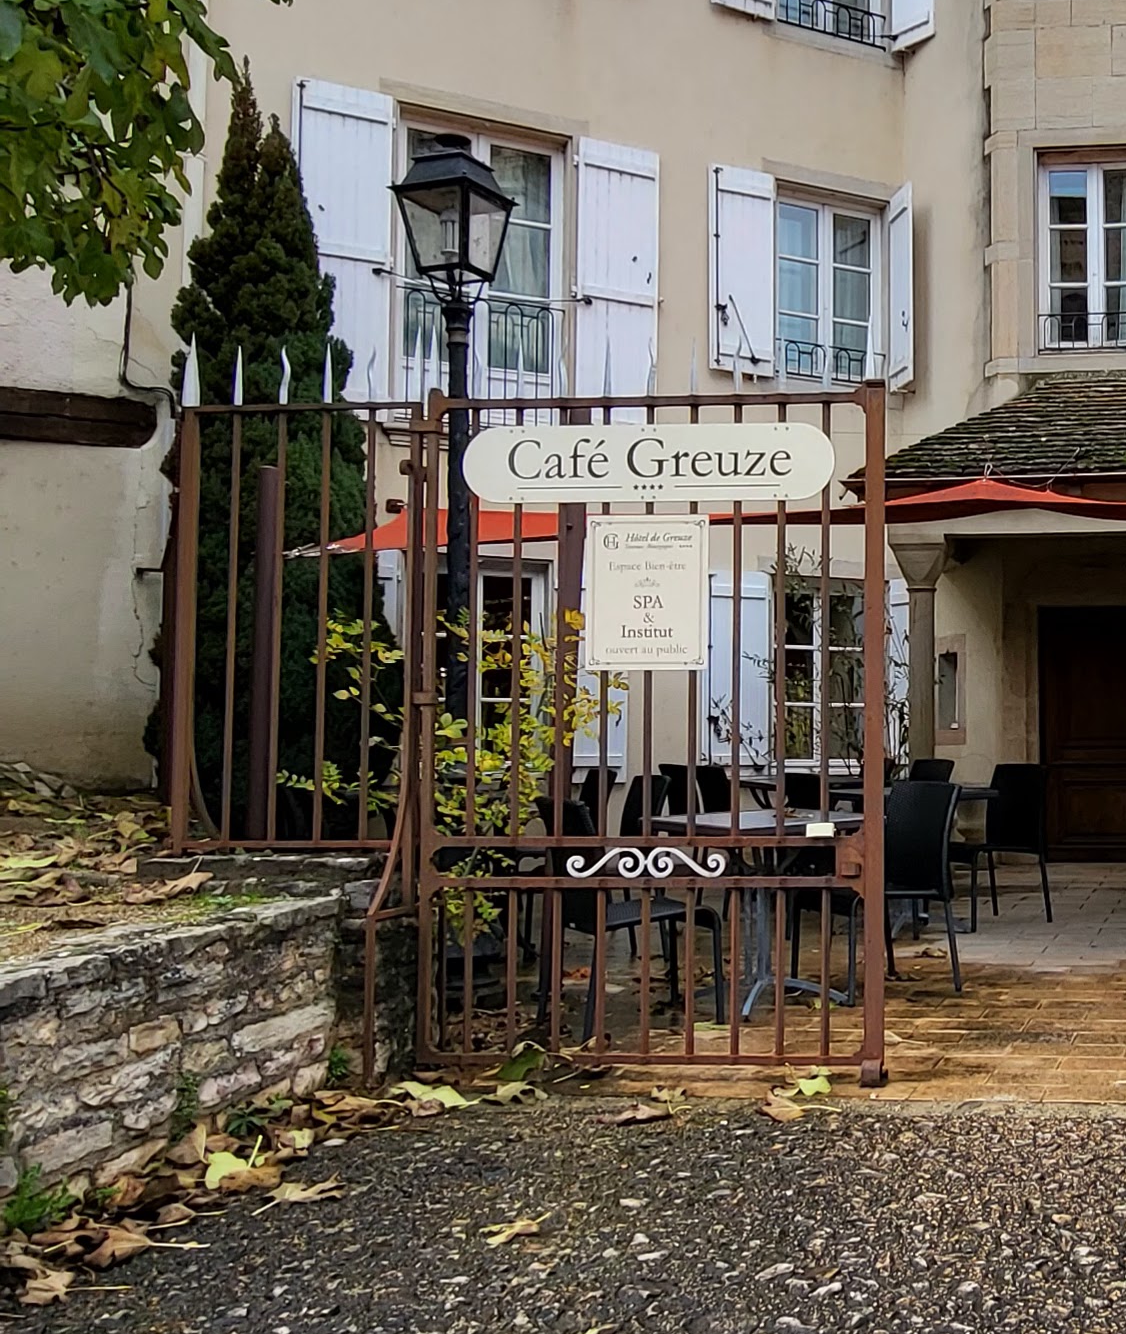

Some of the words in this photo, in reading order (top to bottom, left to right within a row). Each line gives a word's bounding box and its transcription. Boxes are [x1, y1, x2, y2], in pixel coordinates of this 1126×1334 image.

[507, 438, 610, 480] Café
[626, 437, 793, 479] Greuze
[625, 532, 649, 542] Hôtel
[650, 532, 660, 542] de
[662, 533, 693, 542] Greuze
[633, 595, 664, 609] SPA
[643, 612, 655, 624] &
[621, 624, 673, 638] Institut
[605, 646, 638, 655] ouvert
[641, 646, 653, 654] au
[656, 644, 688, 657] public
